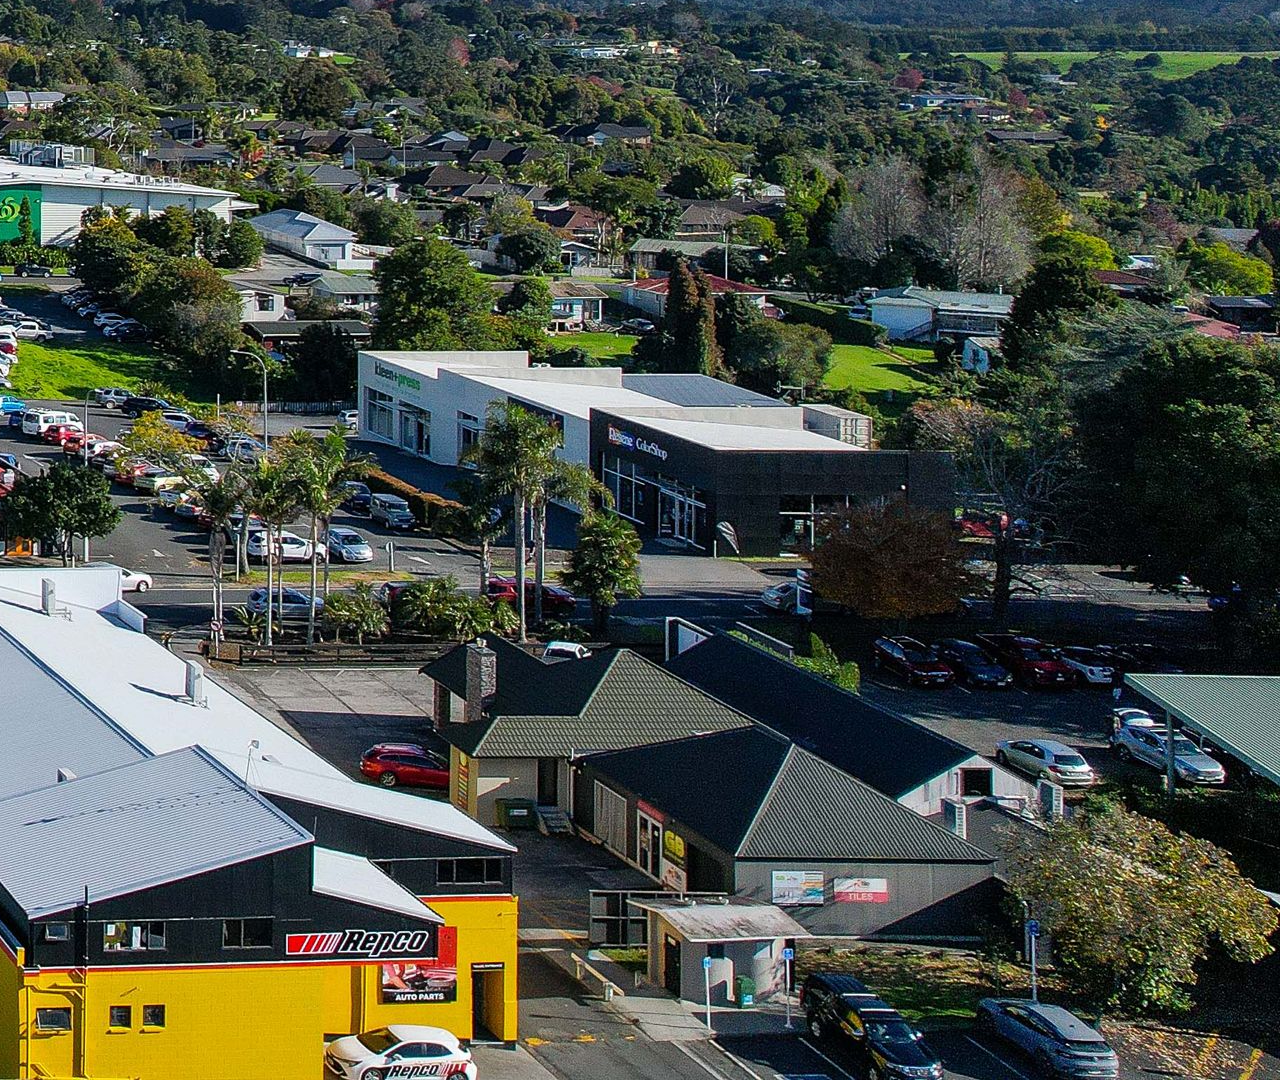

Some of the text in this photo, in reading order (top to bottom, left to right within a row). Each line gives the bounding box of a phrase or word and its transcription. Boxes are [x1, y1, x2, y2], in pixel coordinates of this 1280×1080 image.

[848, 893, 873, 901] TILES
[340, 929, 429, 958] Repco
[395, 992, 444, 1001] AUTO PARTS
[388, 1063, 440, 1079] Repco
